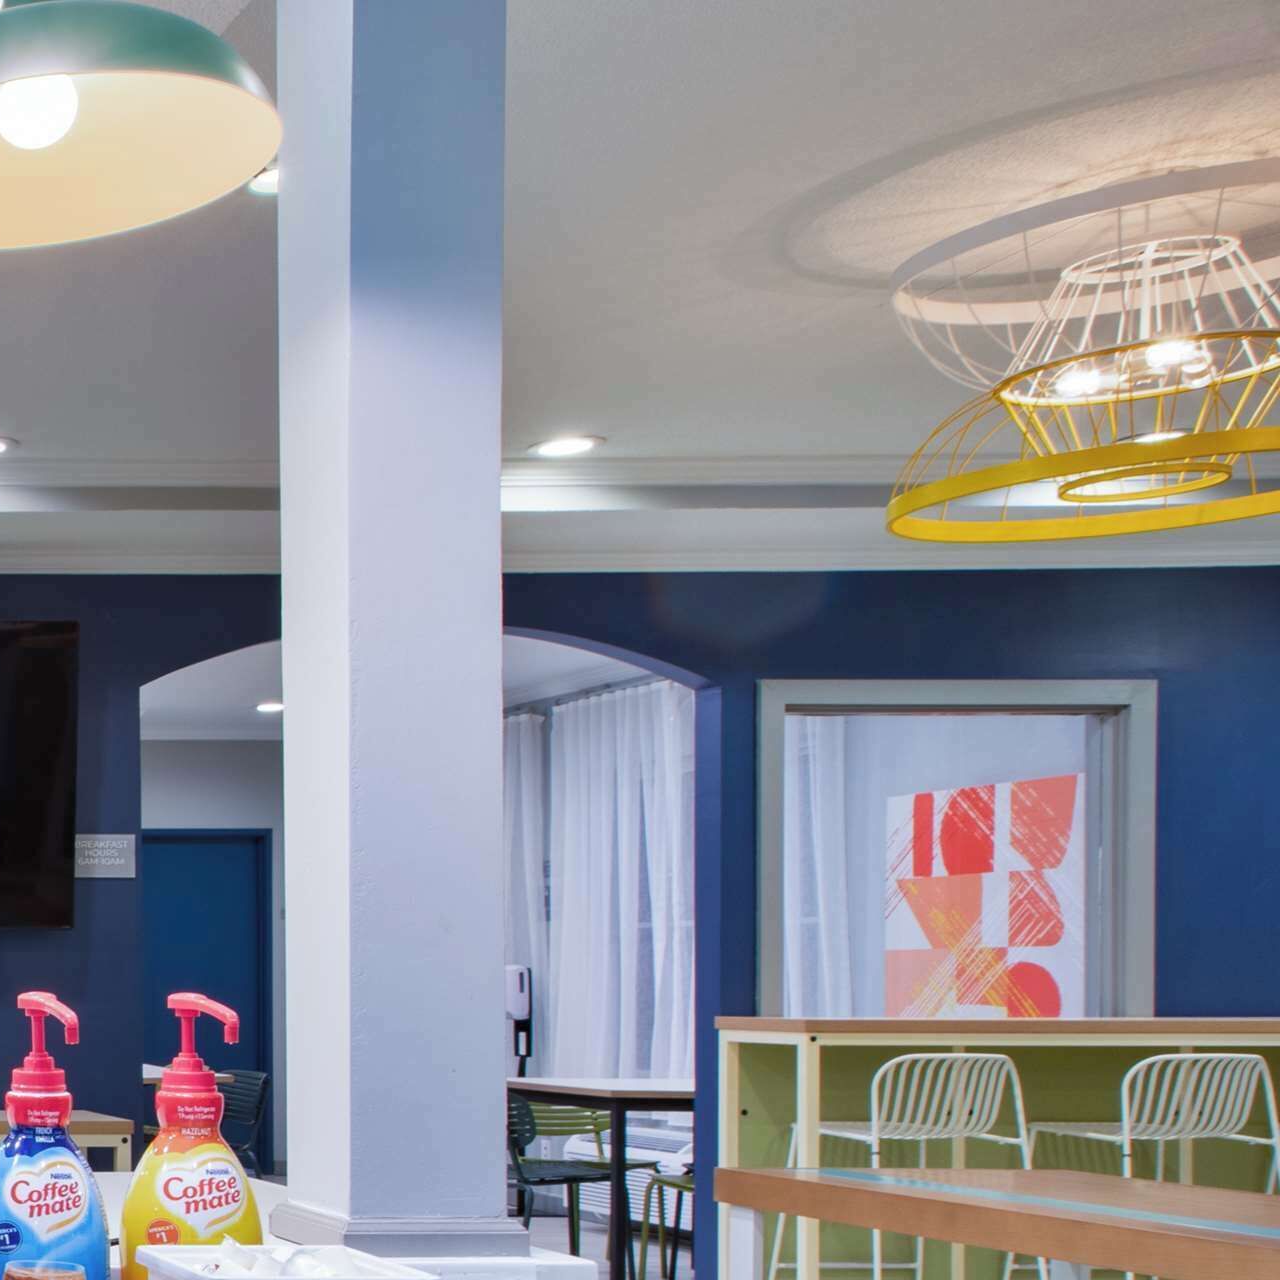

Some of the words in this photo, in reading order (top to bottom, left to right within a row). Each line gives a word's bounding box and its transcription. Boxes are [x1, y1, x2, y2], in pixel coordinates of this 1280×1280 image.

[10, 1180, 79, 1204] Coffee
[163, 1176, 237, 1201] Coffee
[28, 1195, 82, 1218] mate
[185, 1190, 240, 1214] mate
